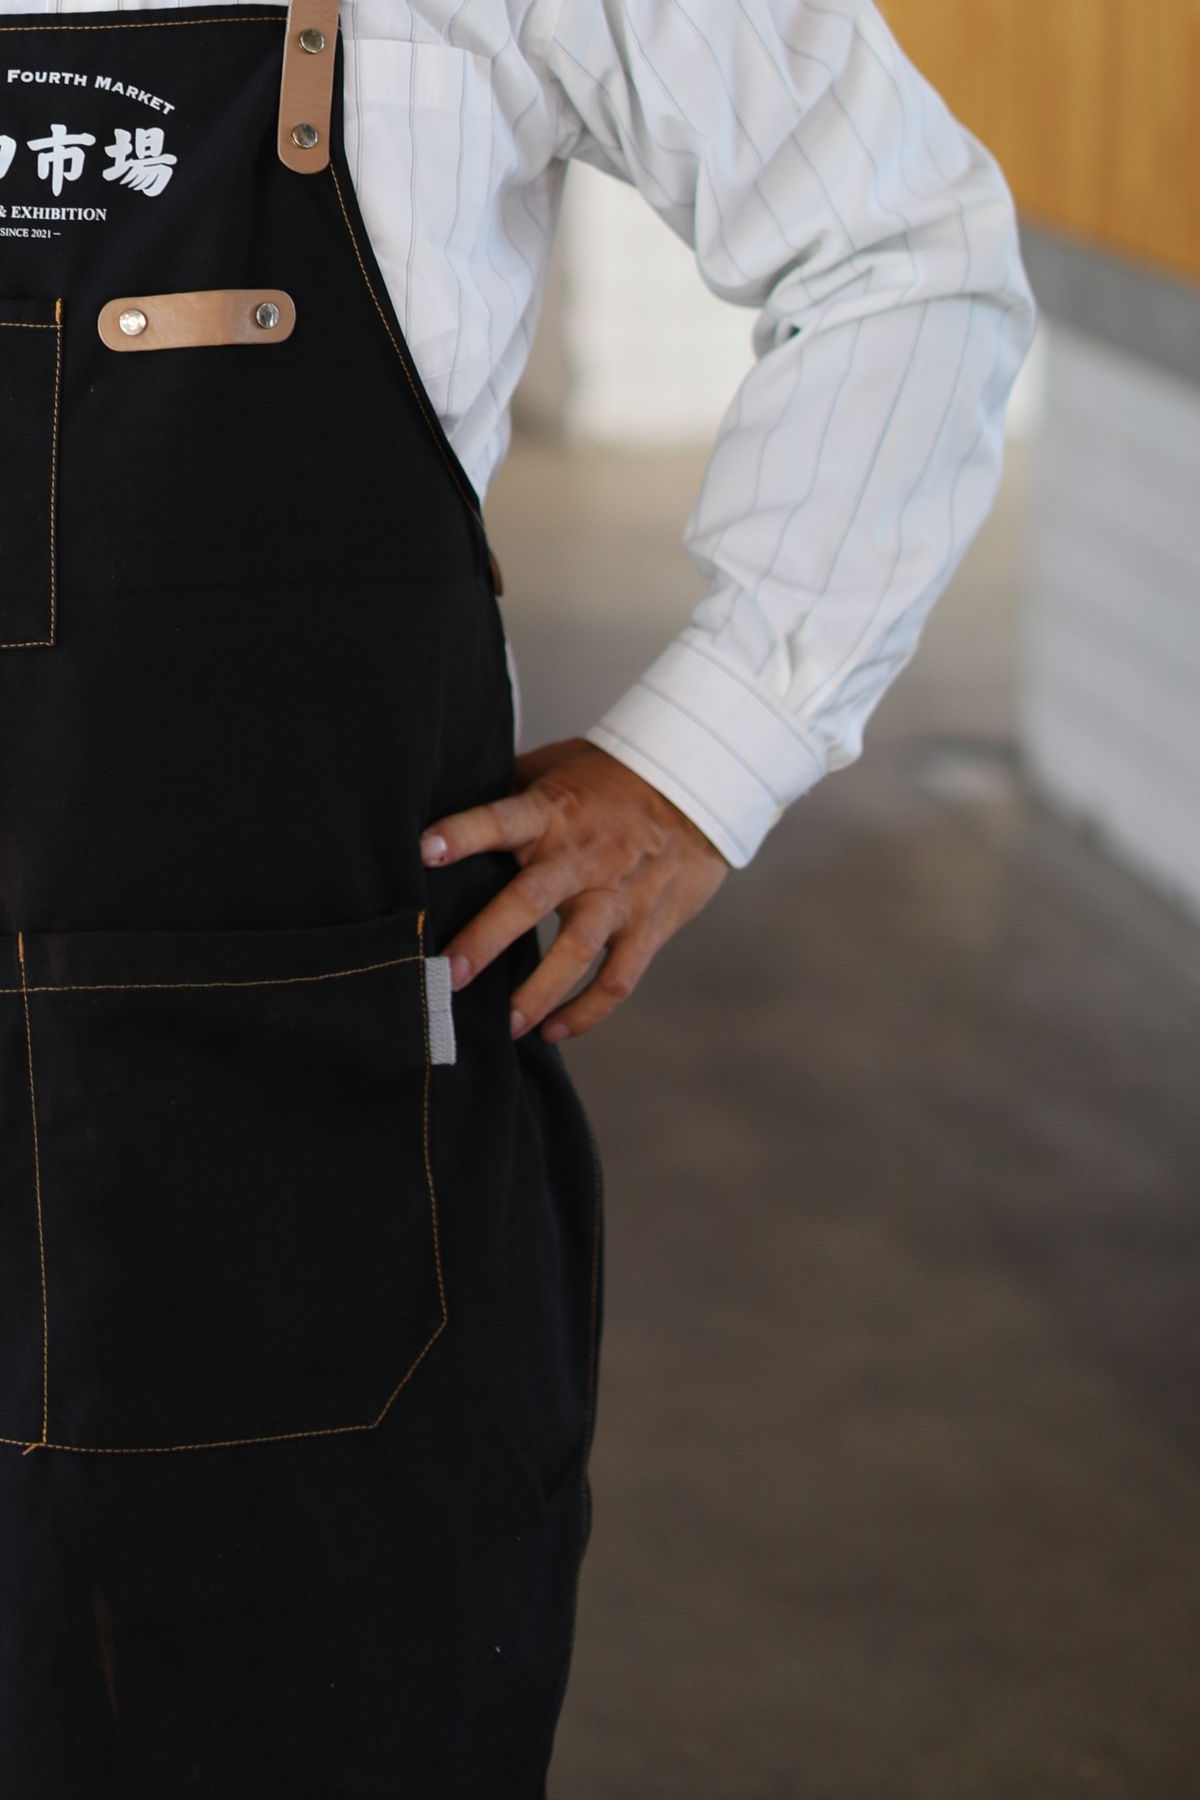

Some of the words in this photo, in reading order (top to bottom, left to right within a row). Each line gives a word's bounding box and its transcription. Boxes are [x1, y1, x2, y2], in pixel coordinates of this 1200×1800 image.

[7, 69, 87, 87] FOURTH
[95, 75, 176, 115] MARKET
[11, 206, 107, 221] EXHIBITION
